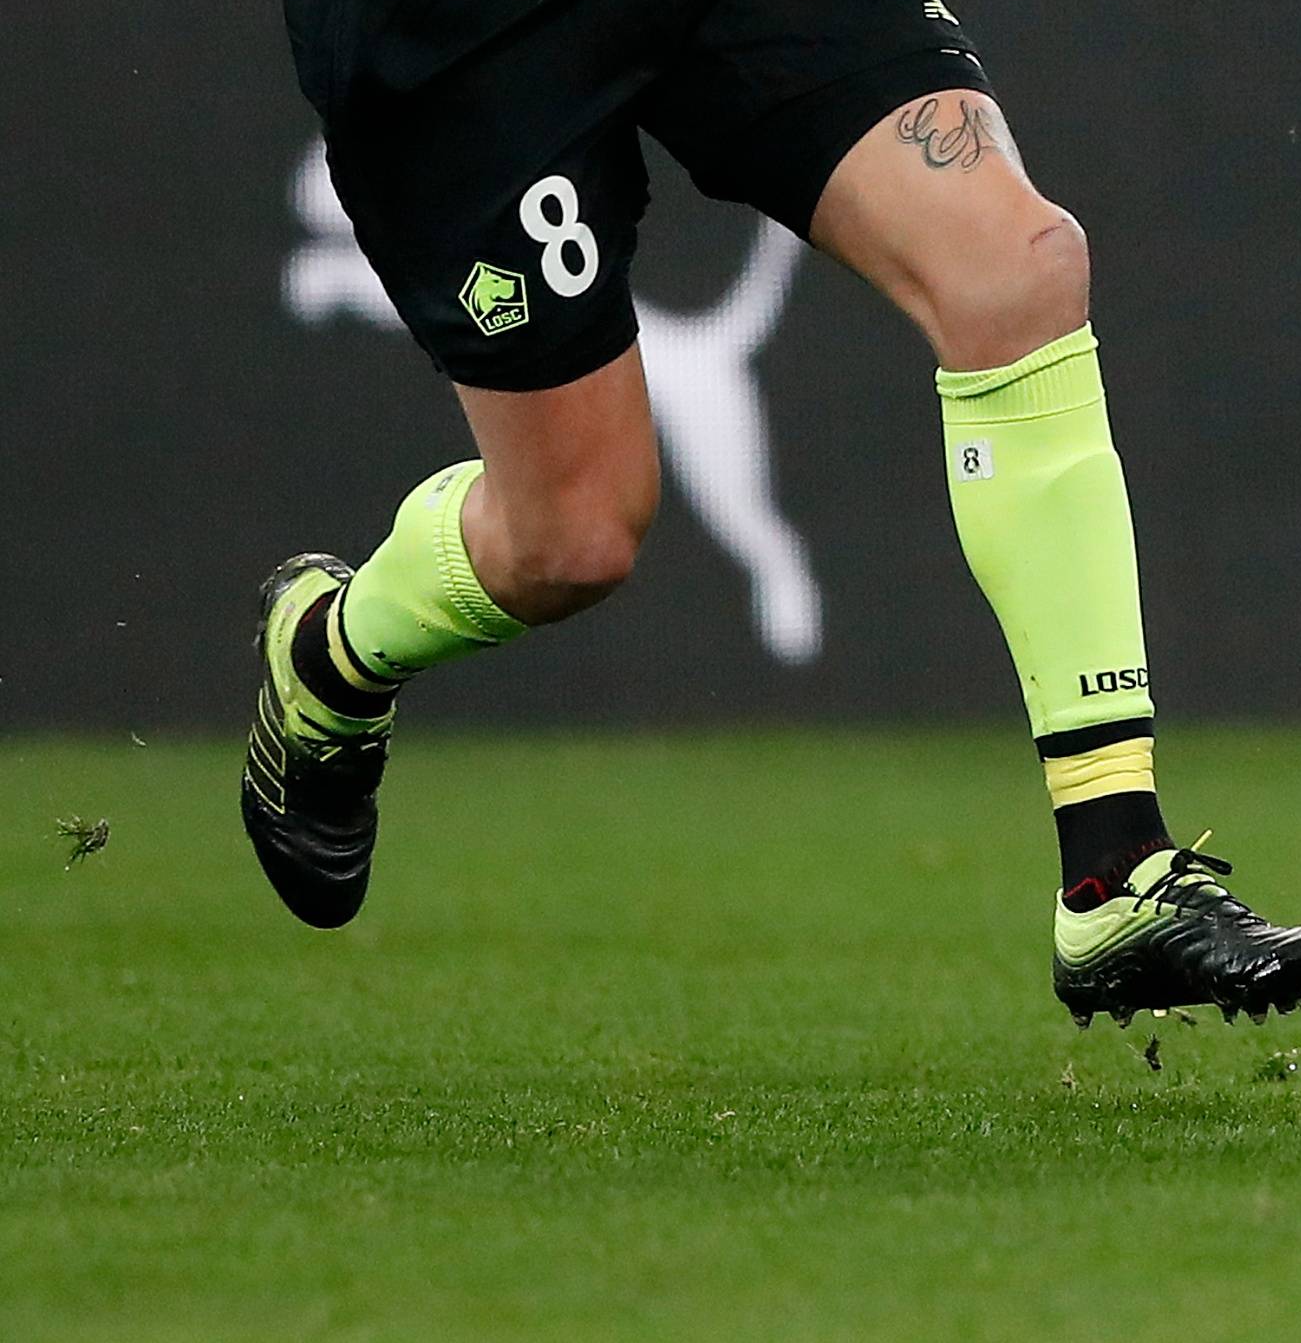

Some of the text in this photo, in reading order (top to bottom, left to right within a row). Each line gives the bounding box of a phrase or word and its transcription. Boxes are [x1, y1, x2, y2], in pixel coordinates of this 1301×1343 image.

[519, 175, 599, 297] 8
[485, 308, 522, 330] LOSC
[963, 446, 980, 474] 8
